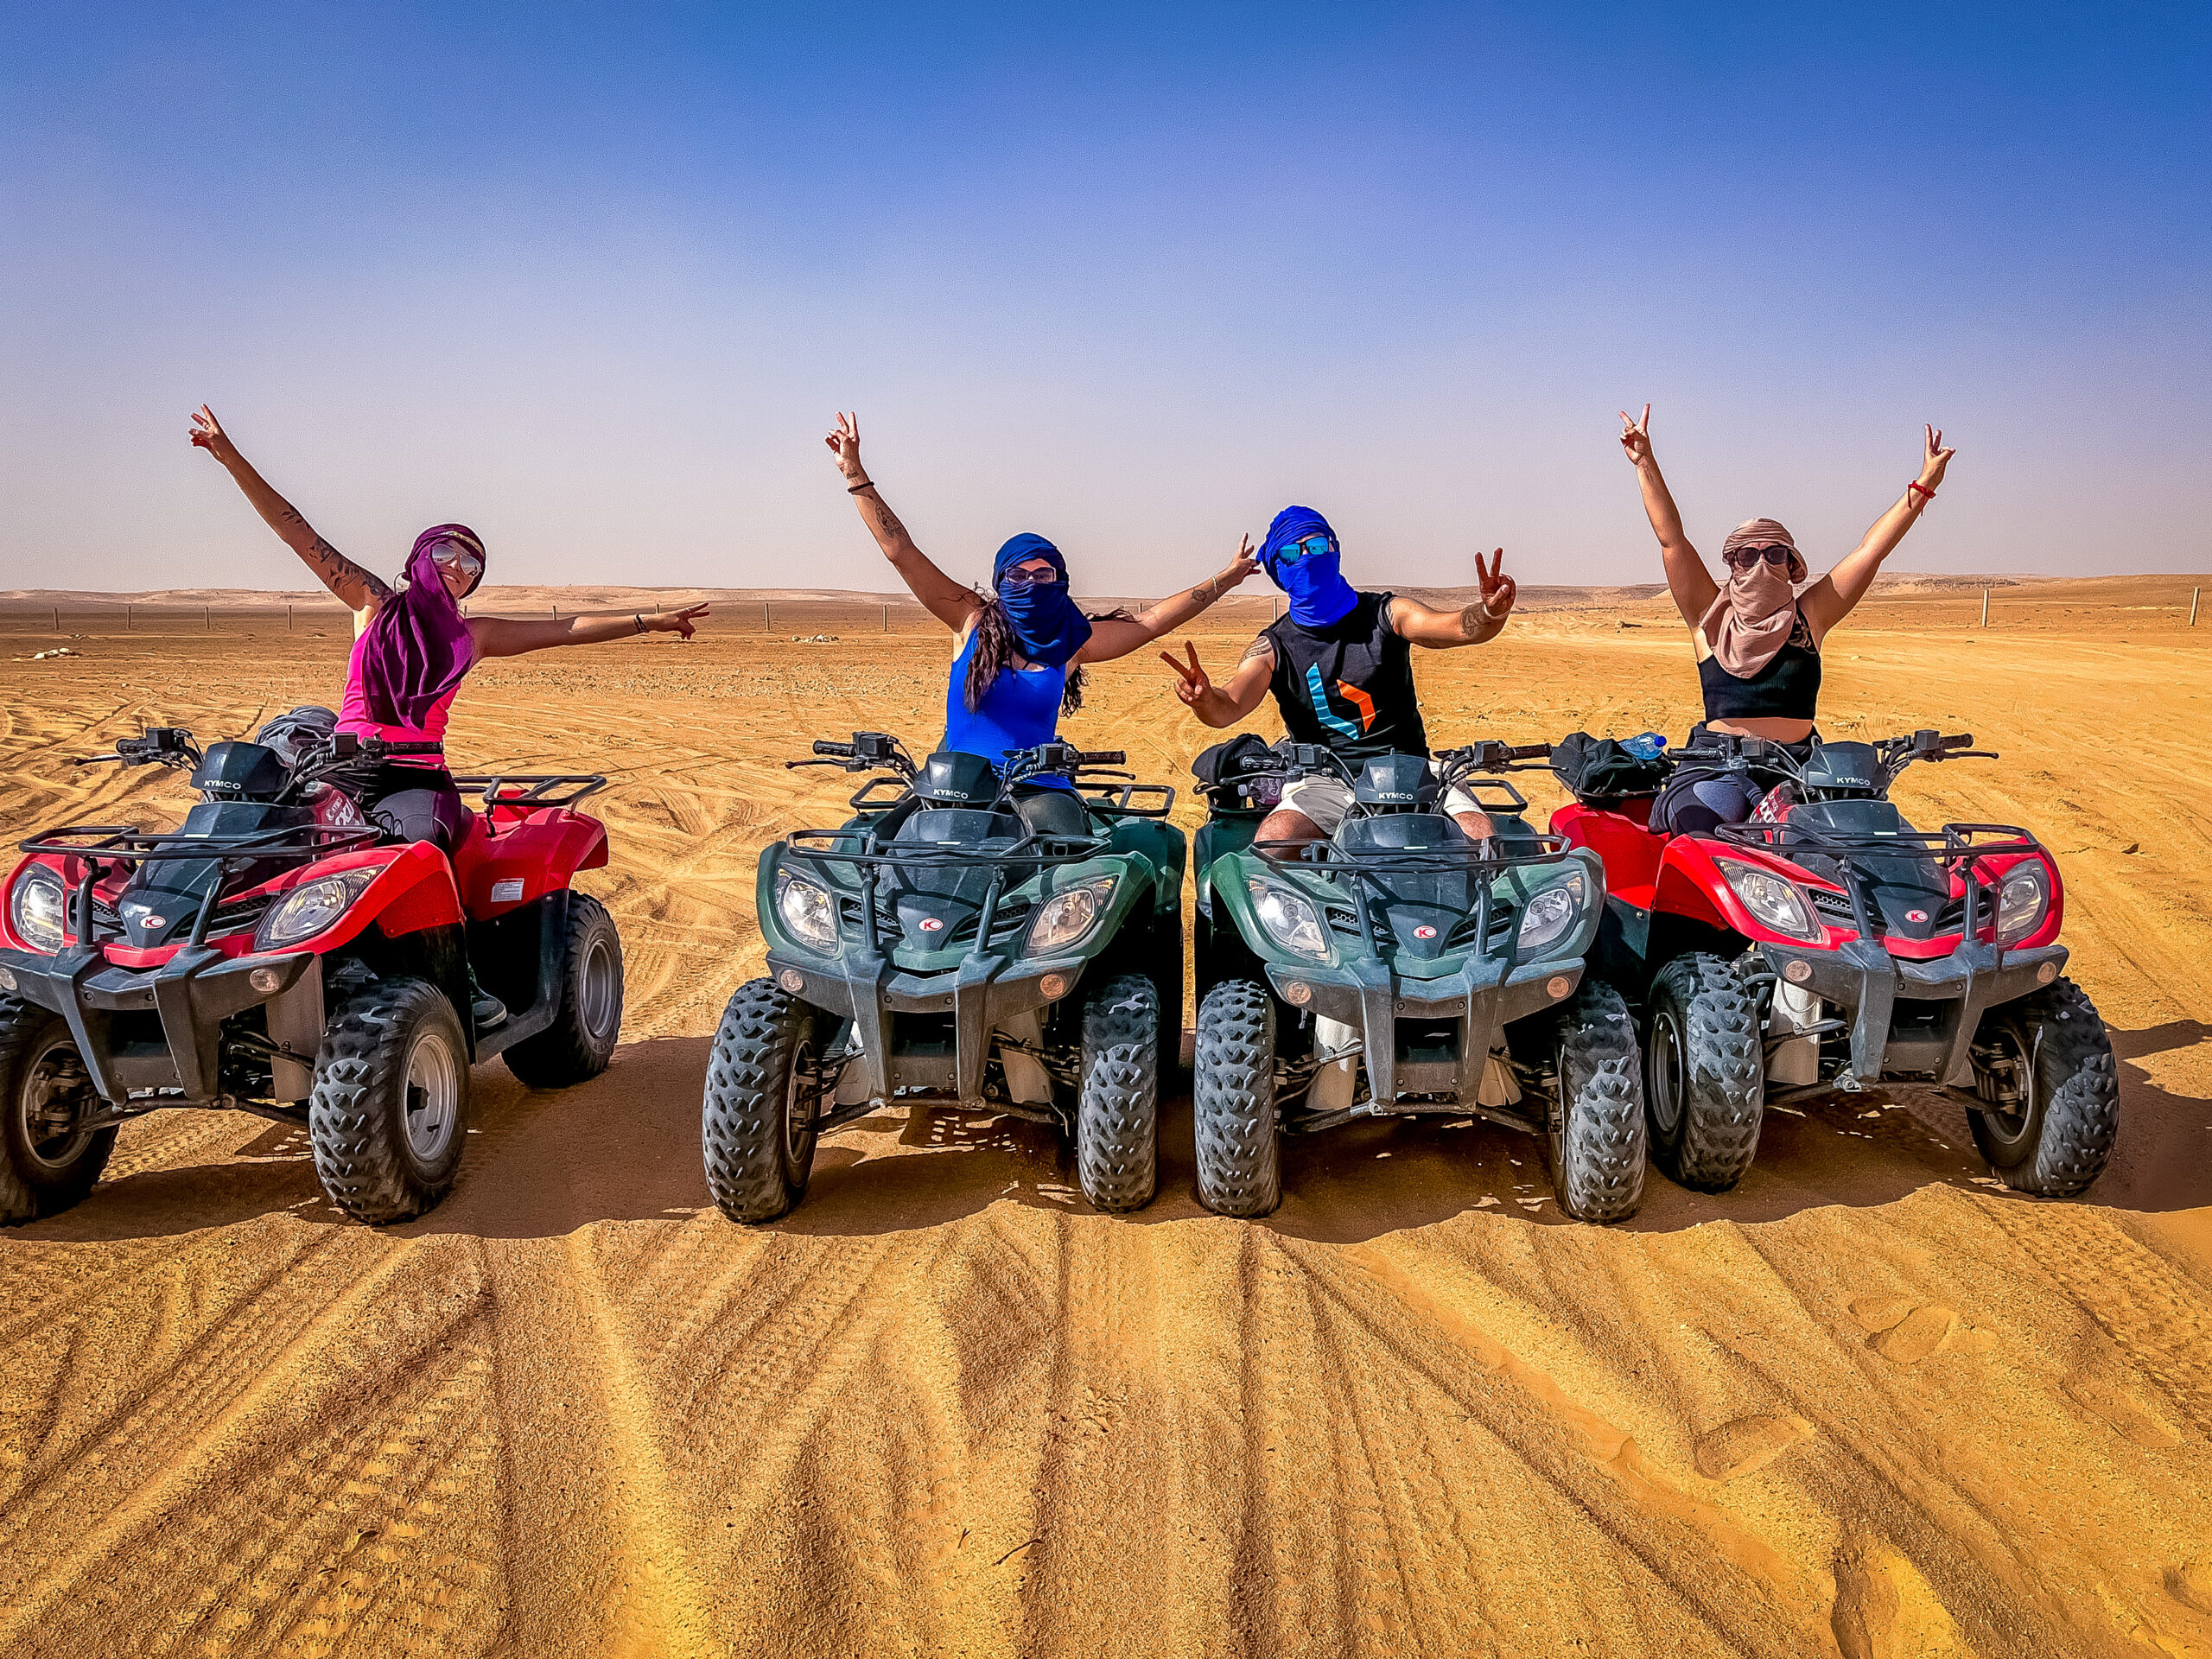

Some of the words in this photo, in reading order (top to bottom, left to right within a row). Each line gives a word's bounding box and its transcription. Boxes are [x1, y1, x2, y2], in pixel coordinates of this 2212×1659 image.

[204, 779, 242, 790] KYMCO
[1836, 777, 1871, 786] KYMCO
[933, 788, 969, 799] KYMCO
[1378, 791, 1414, 800] KYMCO
